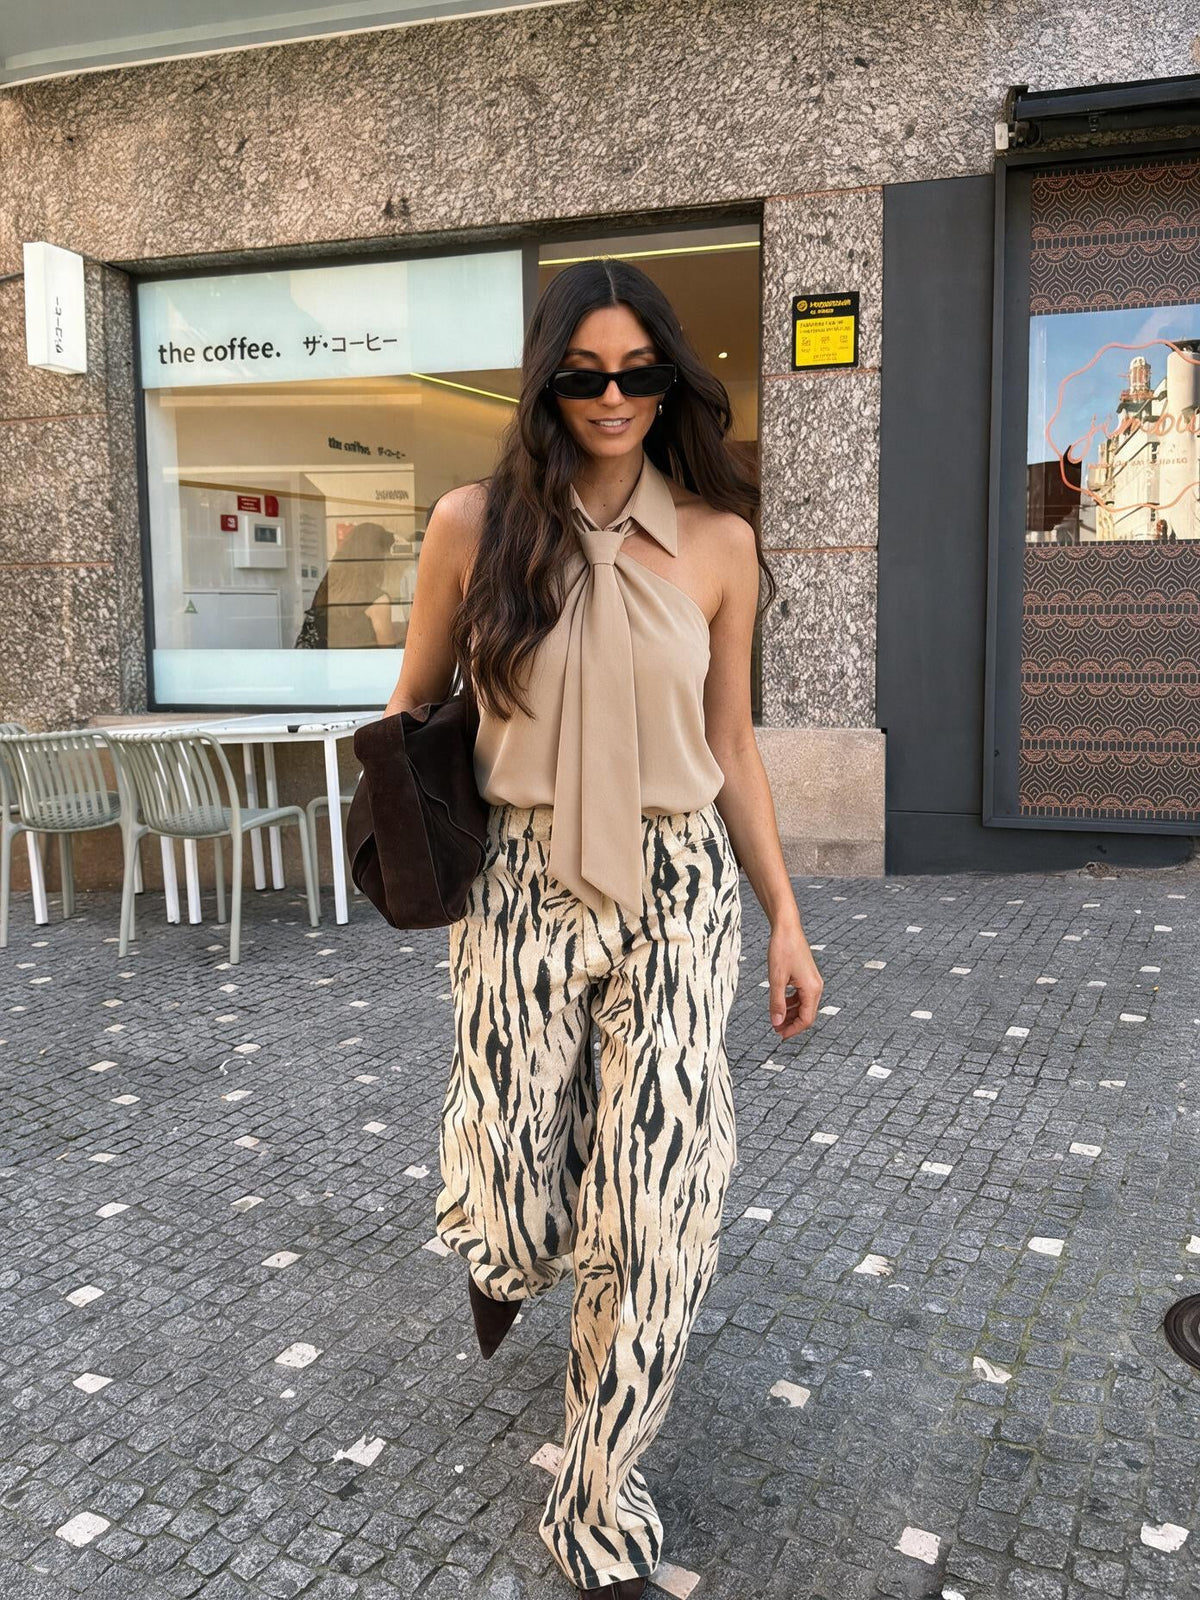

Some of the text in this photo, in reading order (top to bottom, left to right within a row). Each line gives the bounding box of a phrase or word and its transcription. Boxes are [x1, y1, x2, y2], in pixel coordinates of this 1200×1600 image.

[158, 336, 281, 364] the coffee.
[303, 333, 398, 356] ザ・コーヒー
